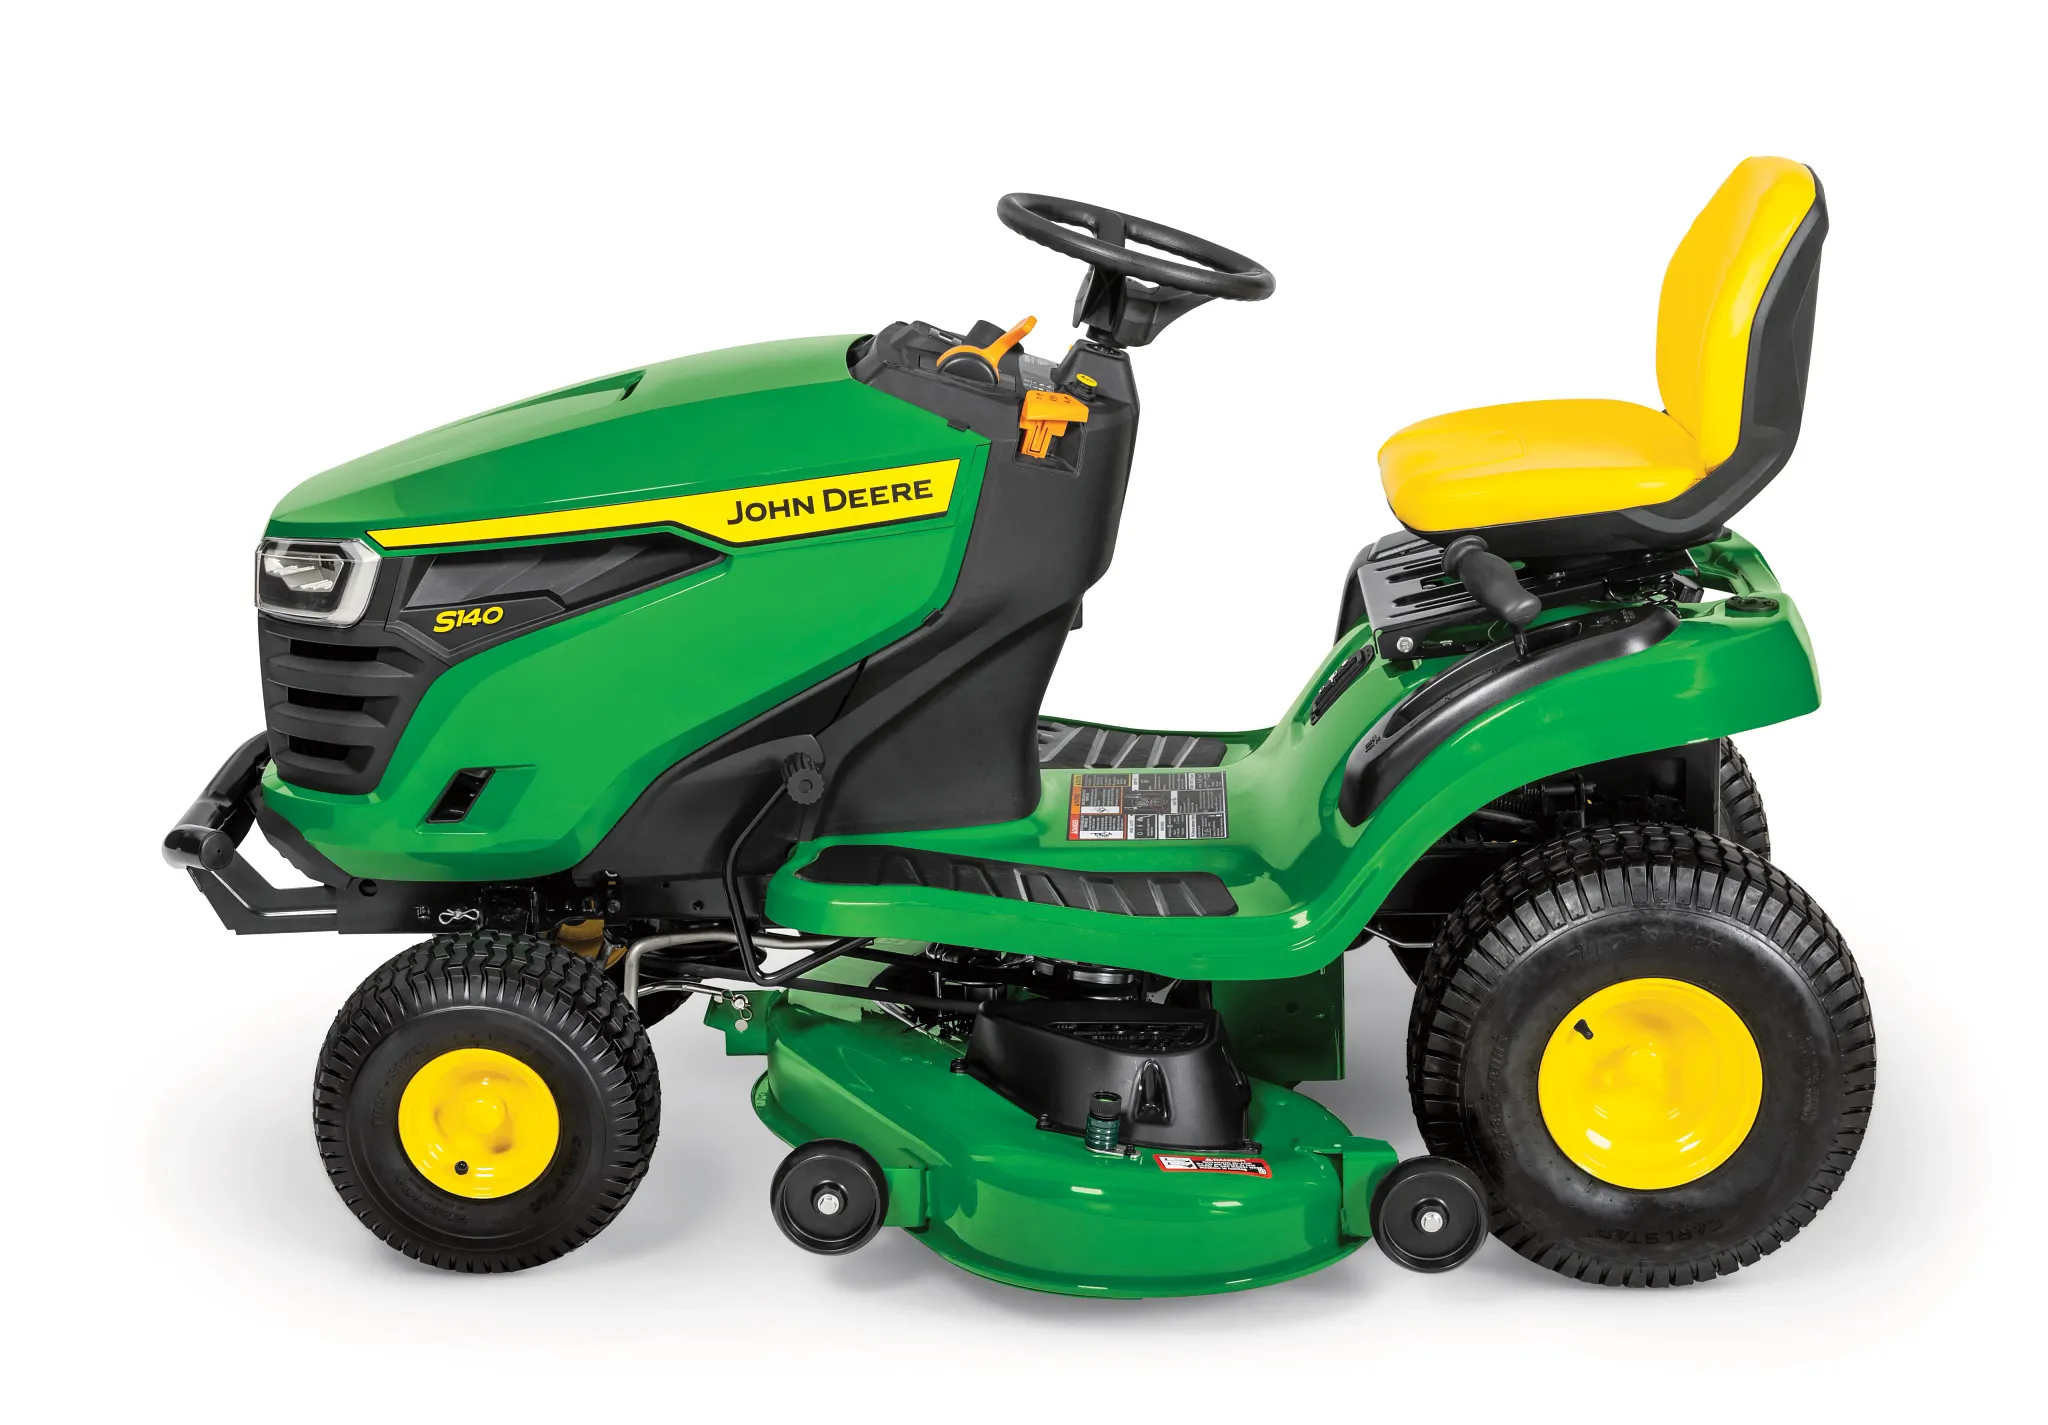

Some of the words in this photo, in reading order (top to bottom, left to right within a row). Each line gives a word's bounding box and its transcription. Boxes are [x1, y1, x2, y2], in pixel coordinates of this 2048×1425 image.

[727, 495, 815, 526] JOHN
[822, 479, 934, 513] DEERE
[433, 605, 504, 633] S140
